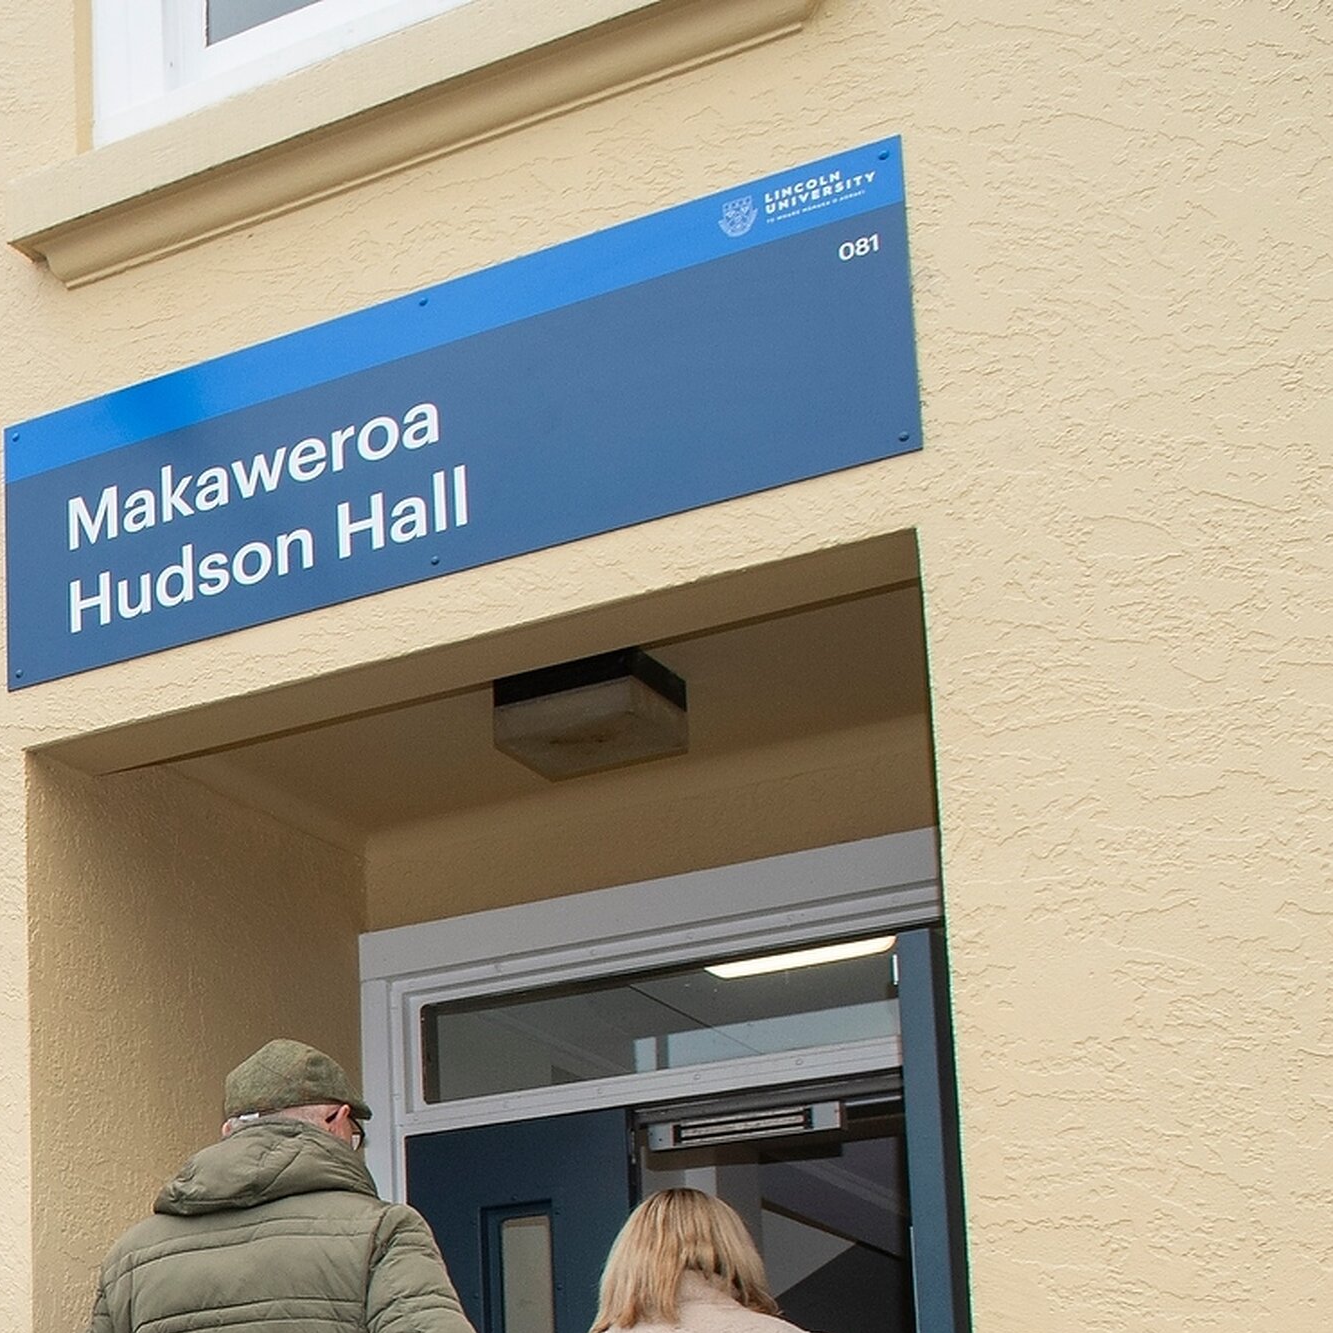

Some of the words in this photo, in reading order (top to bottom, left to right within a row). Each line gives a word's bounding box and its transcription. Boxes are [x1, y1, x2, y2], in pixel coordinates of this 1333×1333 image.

[765, 171, 841, 203] LINCOLN
[765, 171, 875, 213] UNIVERSITY
[838, 233, 879, 261] 081
[67, 403, 440, 551] Makaweroa
[68, 528, 314, 633] Hudson
[337, 464, 469, 559] Hall
